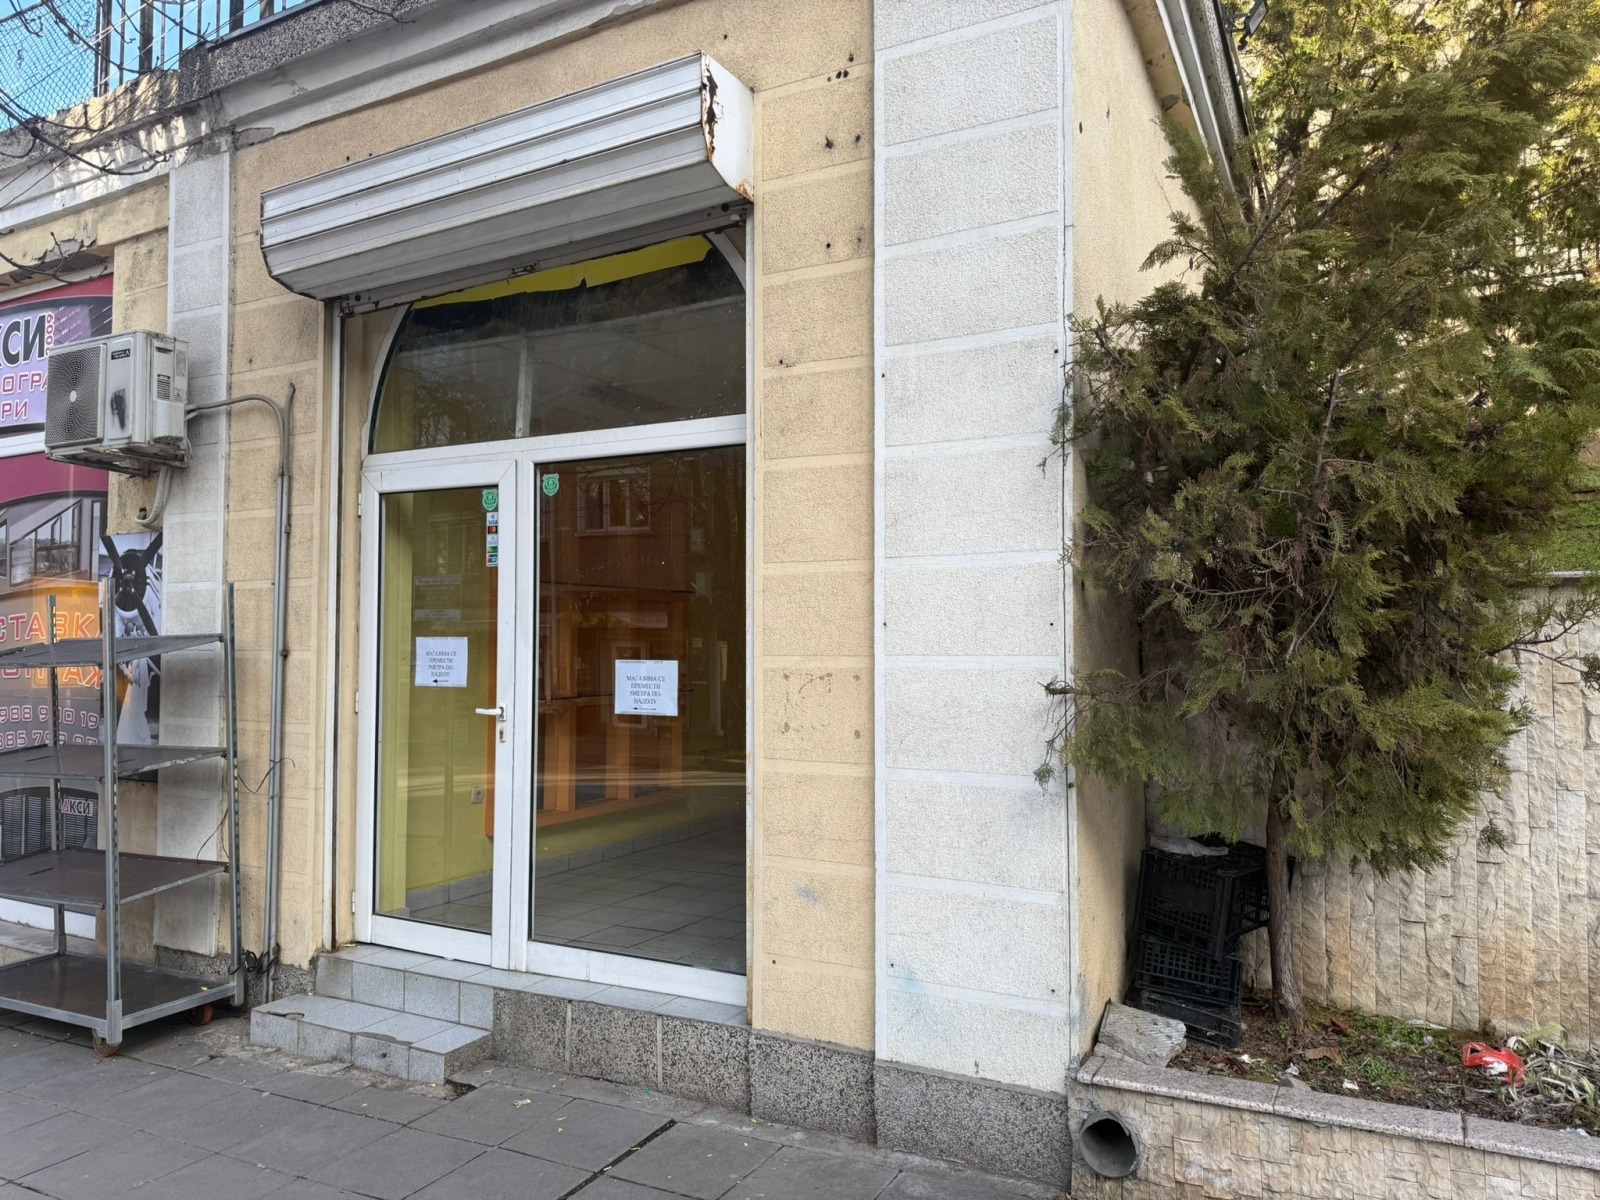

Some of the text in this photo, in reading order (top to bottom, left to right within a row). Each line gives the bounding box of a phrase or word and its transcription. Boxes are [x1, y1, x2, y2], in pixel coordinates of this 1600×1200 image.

[0, 313, 46, 367] СИ
[38, 706, 75, 725] 90
[80, 711, 99, 729] 19
